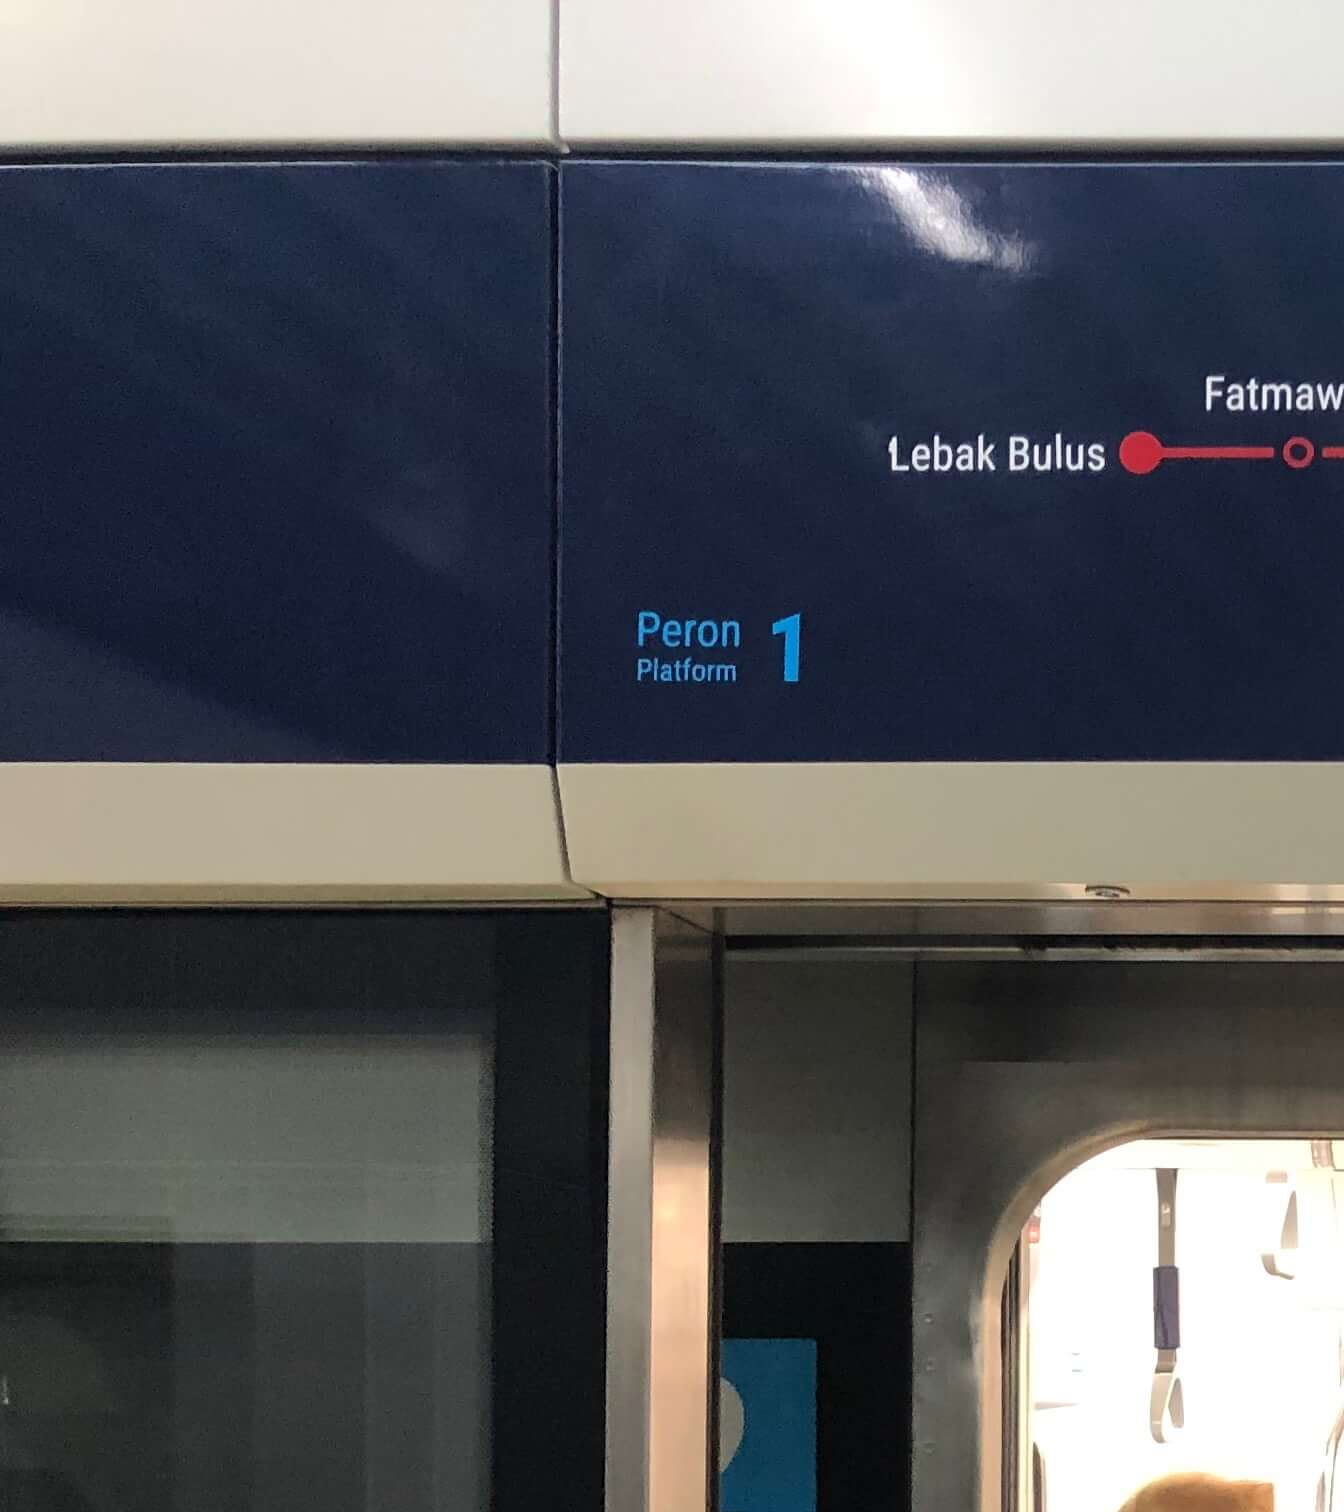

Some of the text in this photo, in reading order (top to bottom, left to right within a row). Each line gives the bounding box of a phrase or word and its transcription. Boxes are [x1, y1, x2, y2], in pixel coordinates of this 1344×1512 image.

[888, 433, 1106, 472] Lebak Bulus
[638, 611, 801, 682] Peron 1
[637, 657, 737, 682] Platform
